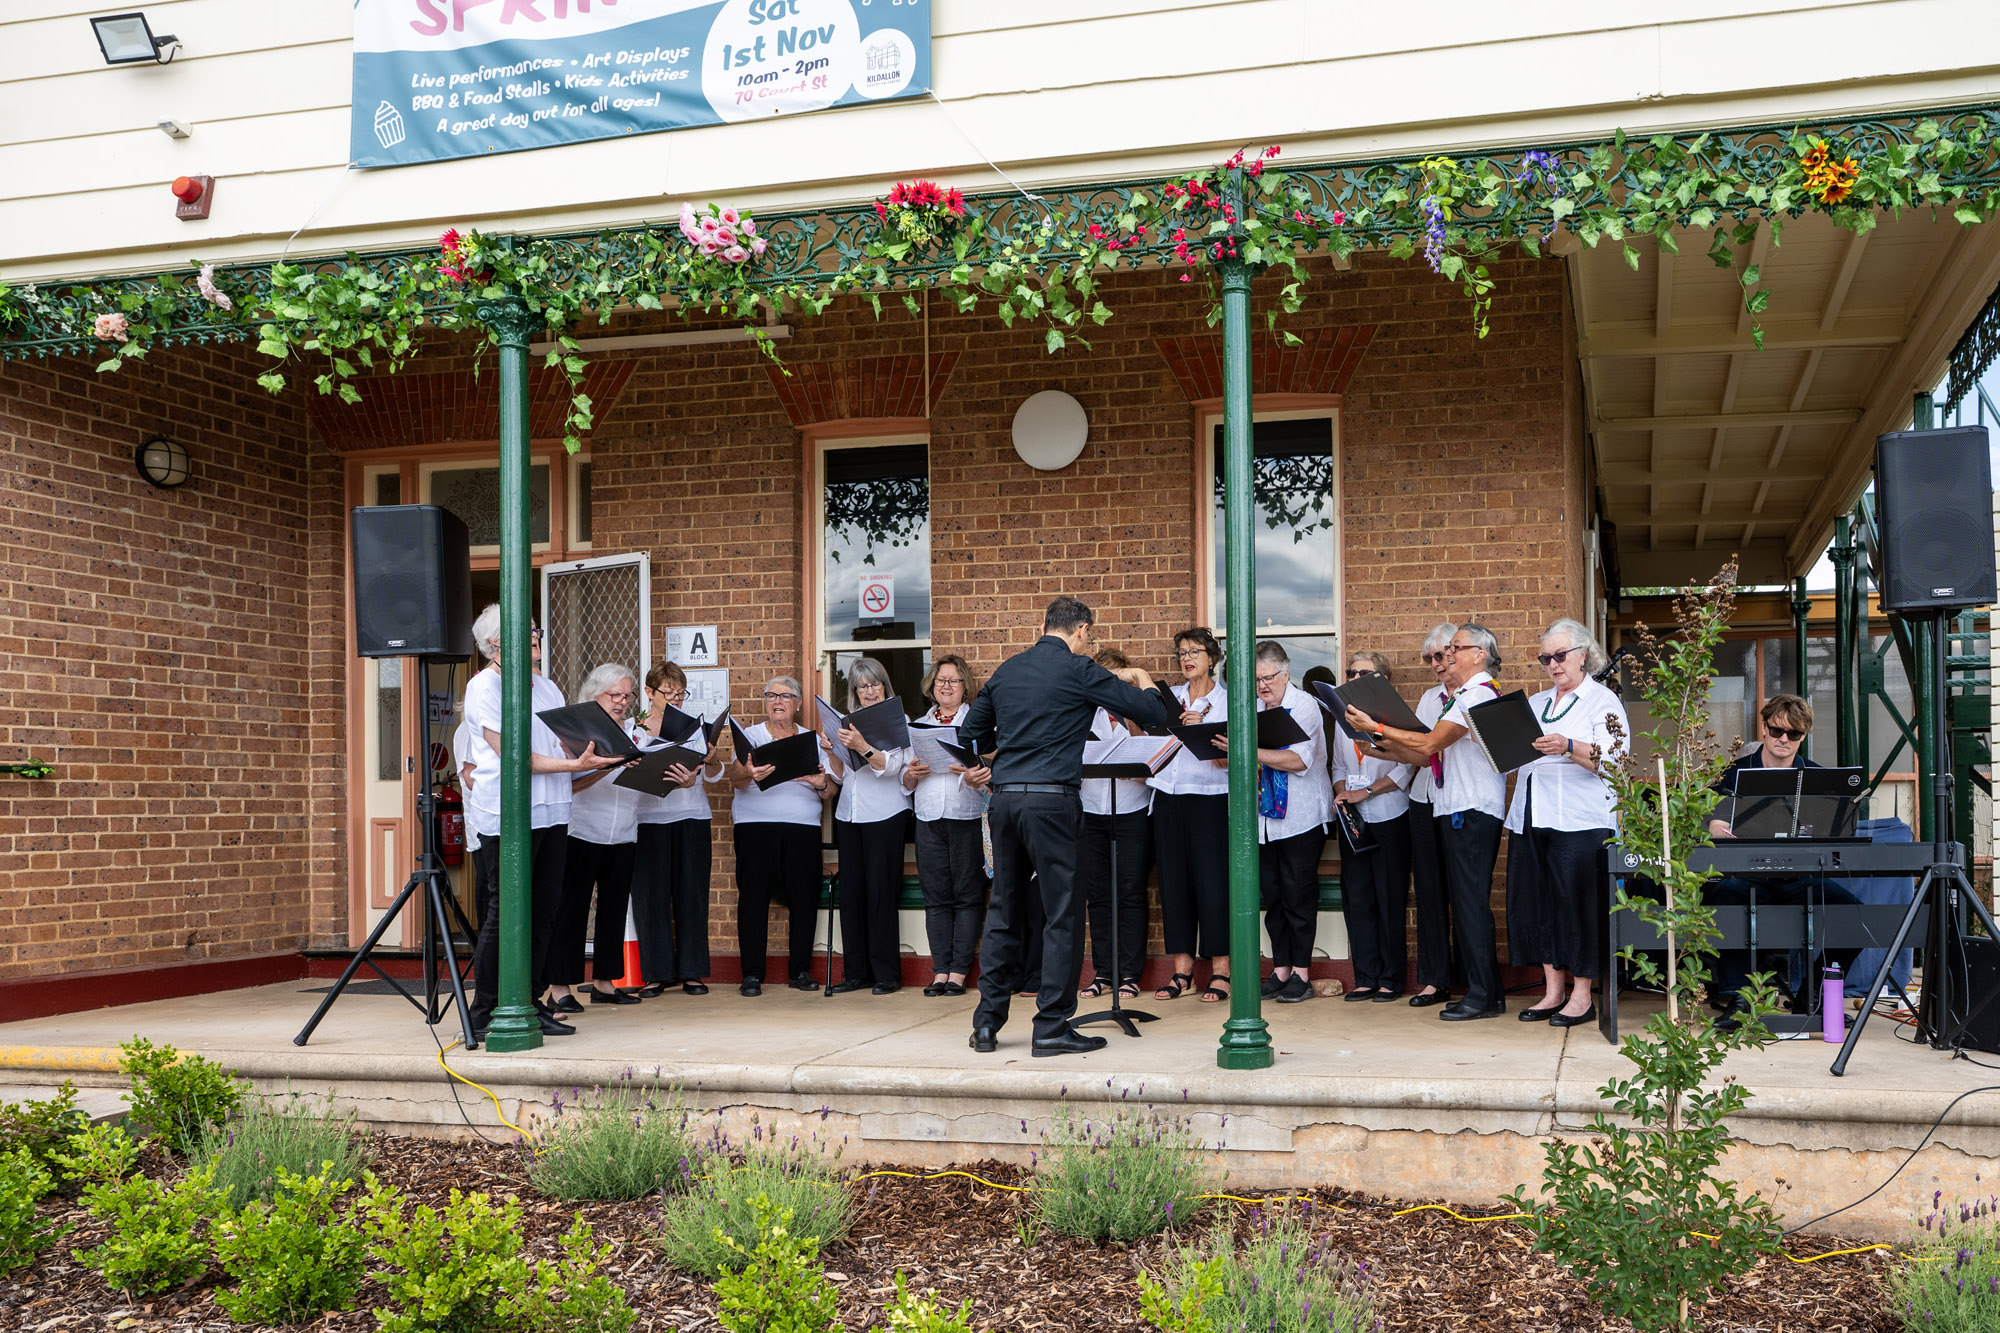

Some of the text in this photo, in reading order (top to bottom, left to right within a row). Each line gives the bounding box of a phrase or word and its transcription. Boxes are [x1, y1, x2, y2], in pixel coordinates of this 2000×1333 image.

[748, 0, 800, 25] Sat
[723, 24, 835, 71] 1st Nov
[411, 47, 690, 89] Live performances Art Displays
[737, 71, 779, 87] 10am
[795, 57, 829, 76] 2pm
[867, 70, 900, 83] KILDALLON
[412, 68, 690, 111] BBQ & Food Stalls Kids Activities
[735, 74, 828, 105] 70 Court St
[436, 92, 660, 135] A great day out for all ages!
[690, 632, 708, 654] A
